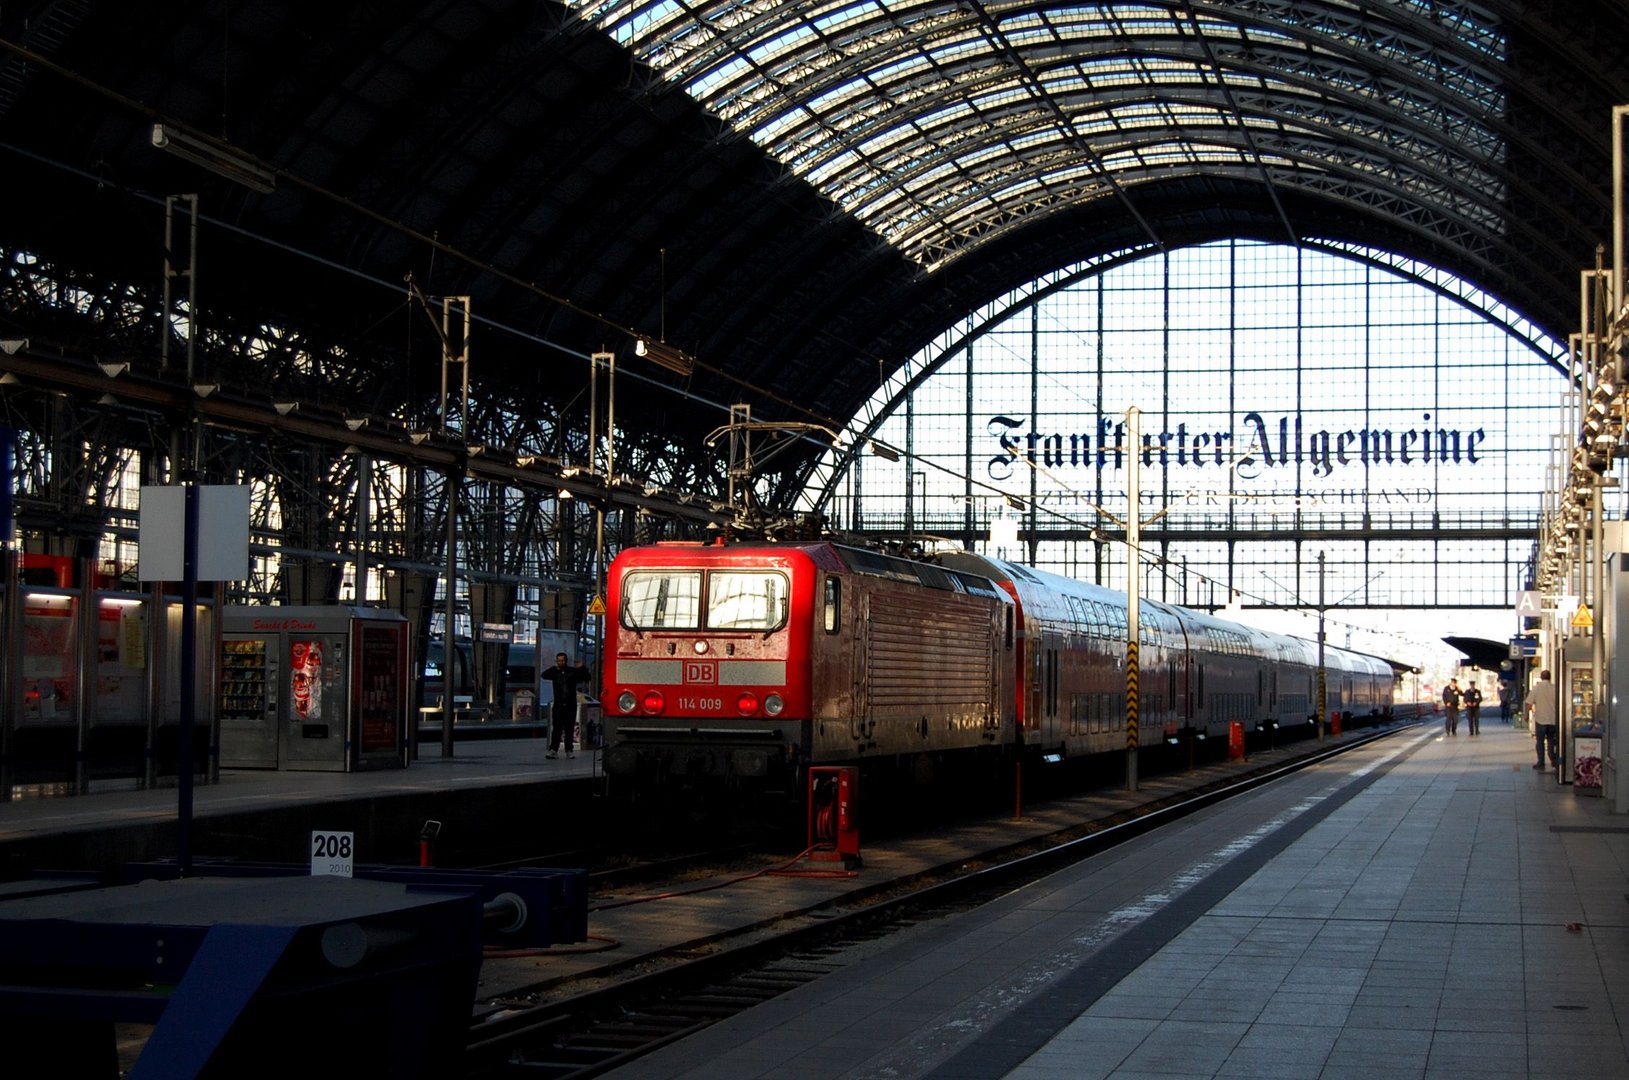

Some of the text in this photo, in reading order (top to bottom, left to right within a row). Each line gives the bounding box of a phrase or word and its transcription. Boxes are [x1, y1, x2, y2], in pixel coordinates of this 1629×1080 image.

[1236, 411, 1486, 479] Allgemeine
[1234, 488, 1433, 506] DEUTSCHLAND
[1519, 591, 1535, 611] A
[688, 665, 712, 680] DB
[679, 698, 721, 709] 114 009
[314, 834, 351, 858] 208
[330, 864, 351, 873] 2010
